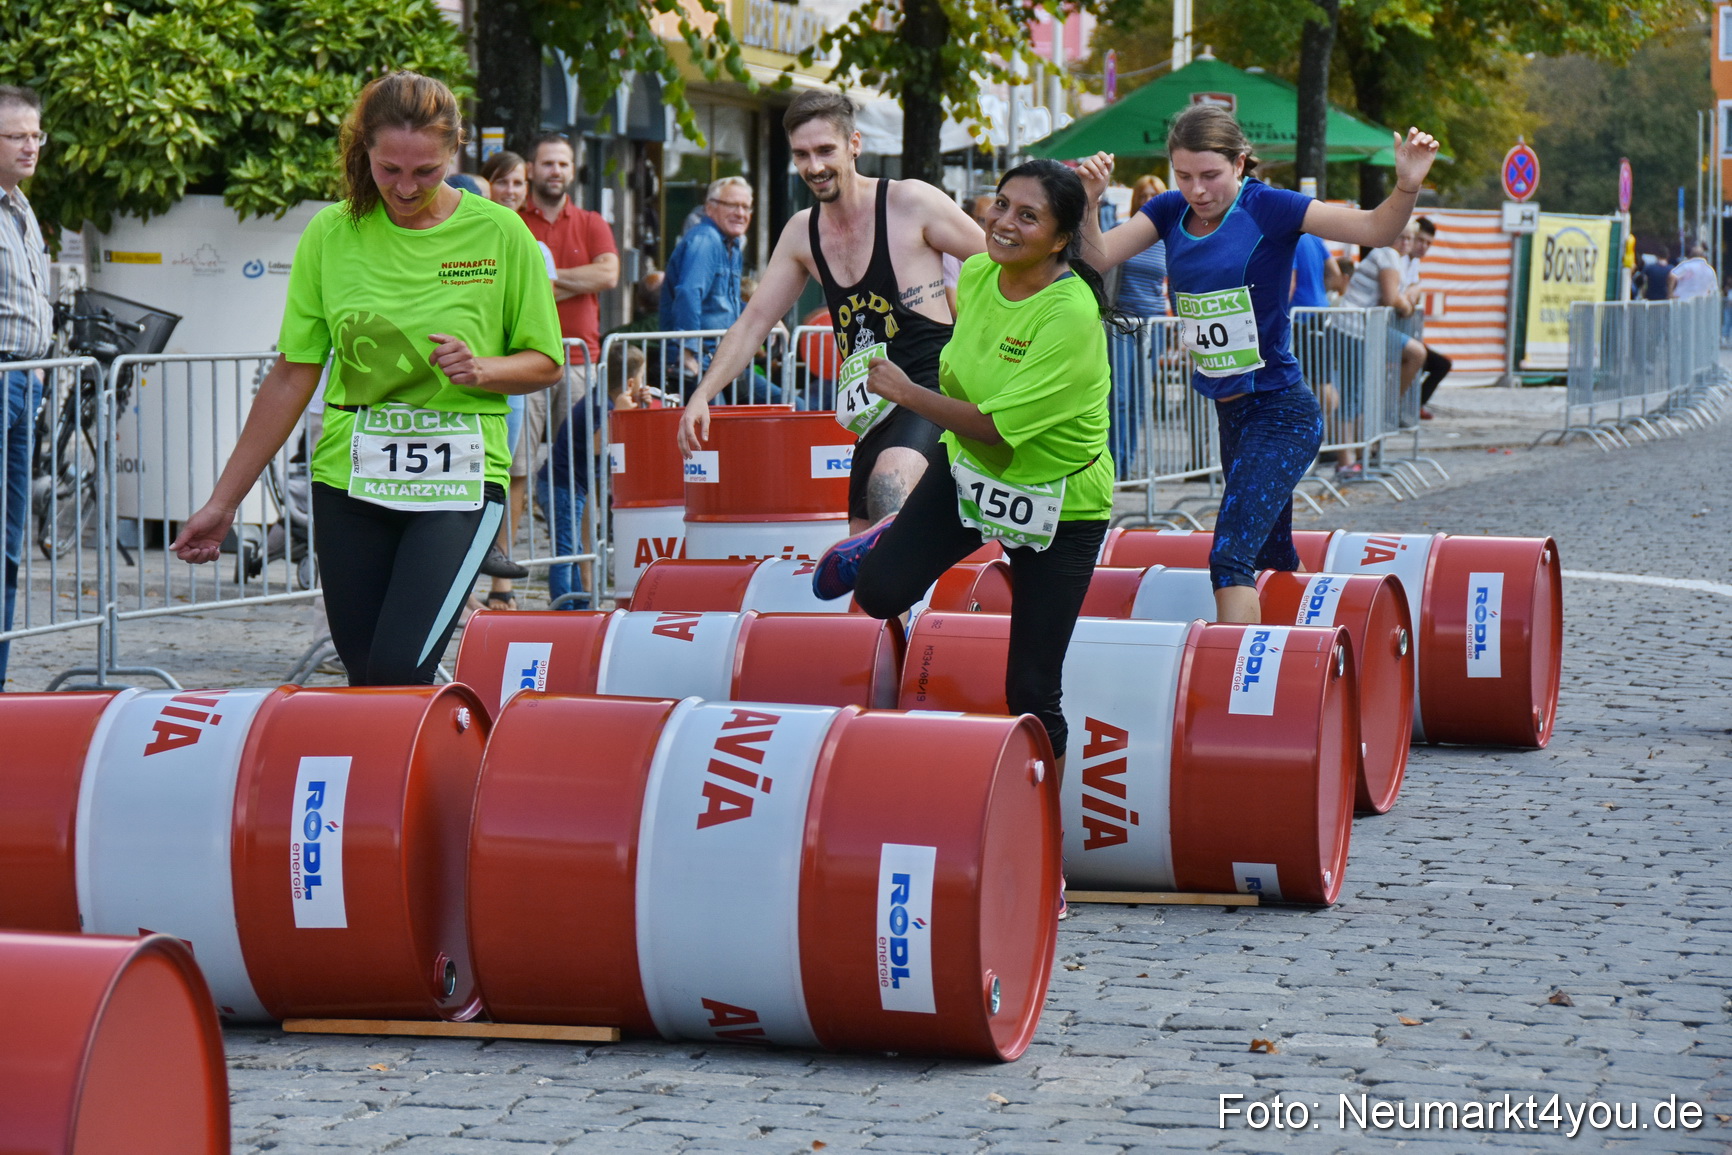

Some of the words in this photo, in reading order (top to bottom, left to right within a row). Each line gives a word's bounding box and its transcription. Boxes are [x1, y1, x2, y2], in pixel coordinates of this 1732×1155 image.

[438, 268, 498, 277] ELEMENTELAUF
[441, 259, 496, 269] NEUMARKTER
[1180, 293, 1243, 316] BOCK
[1196, 323, 1229, 349] 40
[1202, 355, 1237, 368] JULIA
[847, 382, 870, 412] 41
[365, 409, 467, 433] BOCK
[381, 443, 451, 473] 151
[365, 482, 468, 497] KATARZYNA
[970, 481, 1033, 525] 150
[1298, 595, 1310, 624] energie
[1233, 656, 1246, 692] energie
[292, 843, 302, 900] energie
[878, 936, 888, 988] energie
